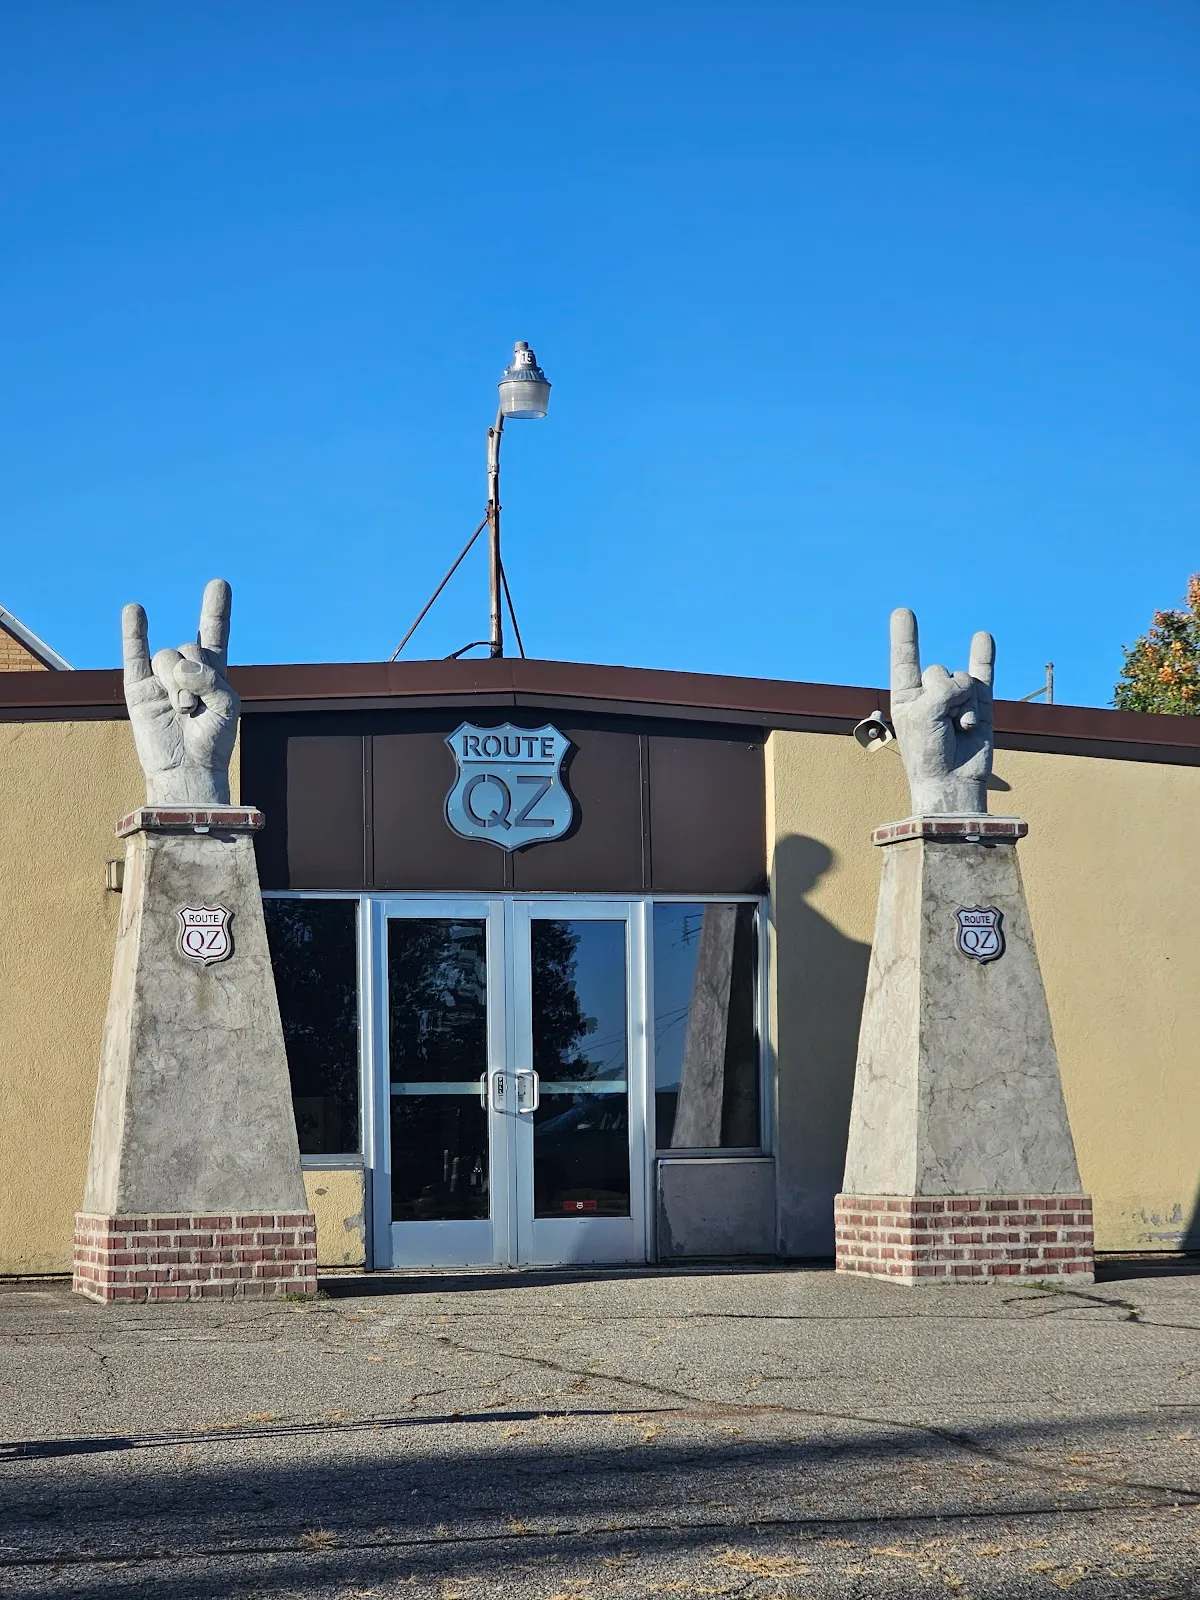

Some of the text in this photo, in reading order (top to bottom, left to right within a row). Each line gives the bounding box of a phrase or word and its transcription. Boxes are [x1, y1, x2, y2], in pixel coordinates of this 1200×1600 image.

[462, 735, 555, 758] ROUTE
[462, 773, 555, 830] QZ
[189, 914, 220, 923] ROUTE
[964, 915, 991, 924] ROUTE
[186, 930, 222, 955] QZ
[963, 930, 995, 954] QZ
